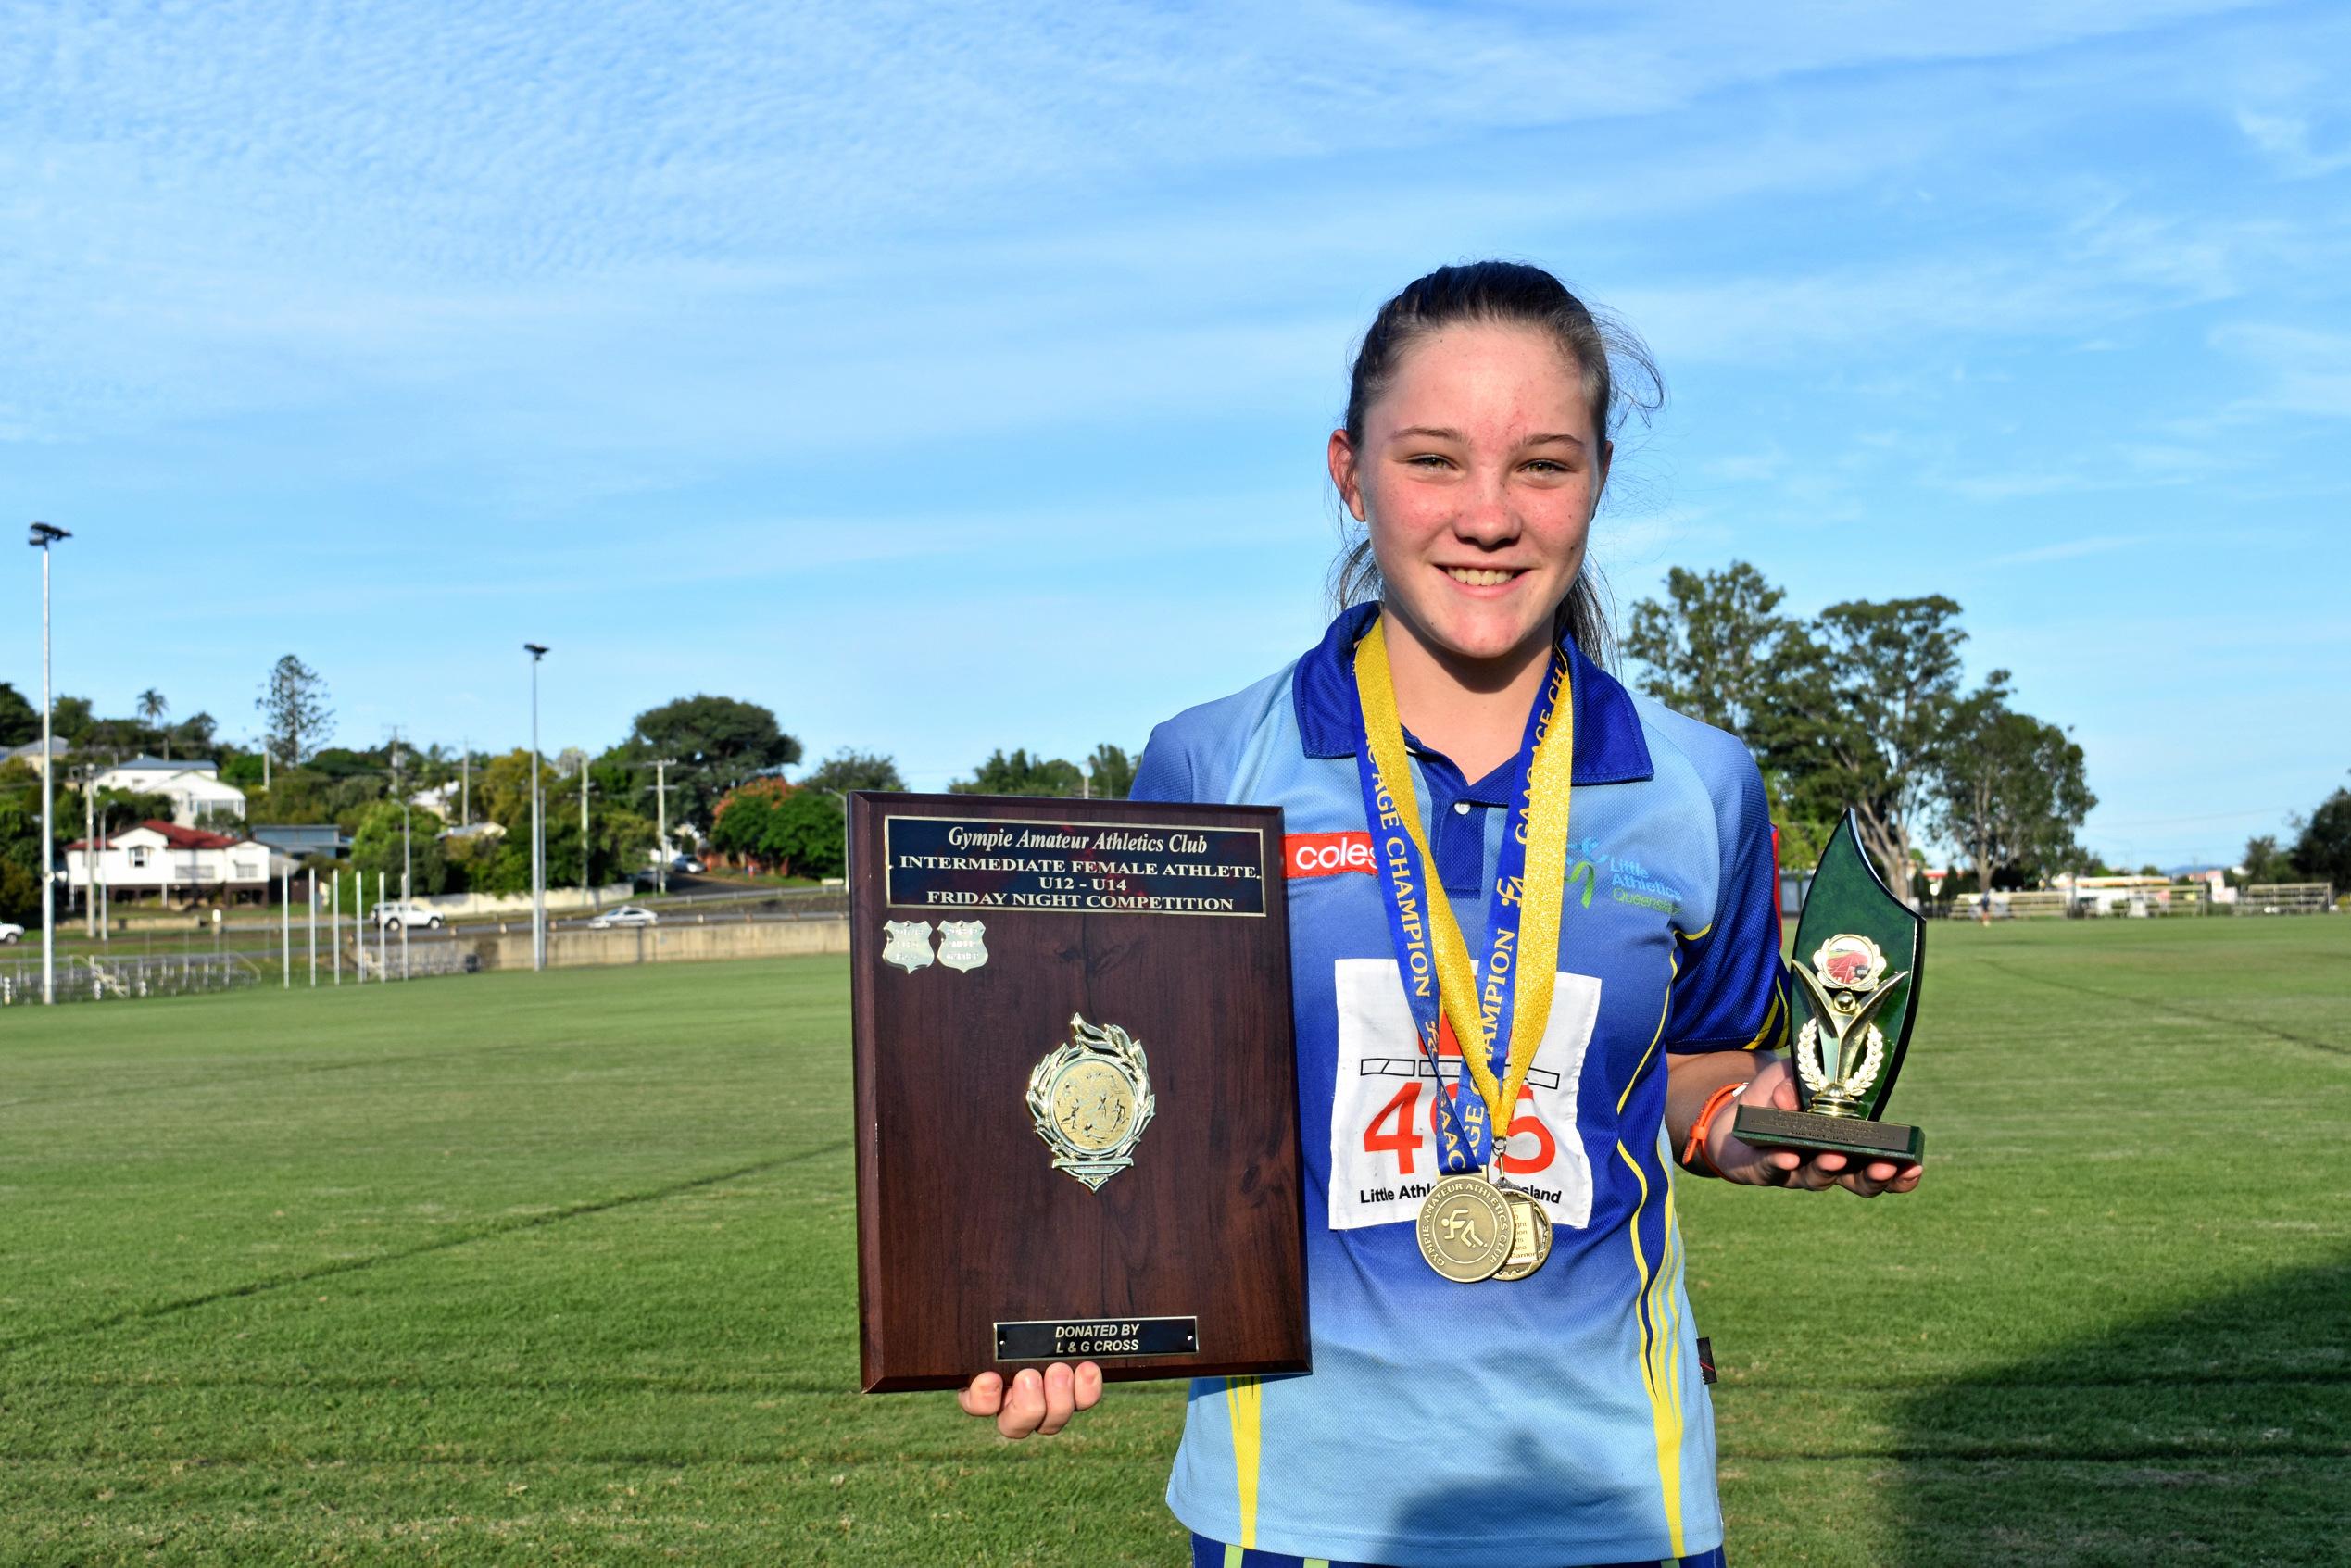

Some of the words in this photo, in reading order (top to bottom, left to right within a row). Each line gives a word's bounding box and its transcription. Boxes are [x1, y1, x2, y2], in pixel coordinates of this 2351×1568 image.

[948, 826, 1014, 851] Gympie
[1016, 829, 1089, 850] Amateur
[1093, 831, 1164, 853] Athletics
[1168, 834, 1208, 854] Club
[899, 855, 1065, 873] INTERMEDIATE
[1072, 861, 1158, 876] FEMALE
[1163, 863, 1255, 878] ATHLETE
[1610, 857, 1650, 878] Little
[1039, 877, 1074, 890] U12
[1092, 879, 1127, 891] U14
[1612, 873, 1682, 901] Athletics
[927, 891, 1007, 905] FRIDAY
[1012, 893, 1081, 908] NIGHT
[1086, 895, 1234, 910] COMPETITION
[1613, 887, 1682, 916] Queens
[1386, 836, 1431, 997] CHAMPION
[1363, 1082, 1556, 1175] 45
[1464, 1104, 1485, 1157] GE
[1360, 1185, 1395, 1204] Little
[1520, 1185, 1562, 1204] sland
[1424, 1183, 1463, 1222] AMATEUR
[1466, 1183, 1508, 1231] ATHLETICS
[1423, 1225, 1445, 1266] GYMPIE
[1489, 1234, 1507, 1263] CLUB
[1055, 1325, 1117, 1338] DONATED
[1121, 1323, 1139, 1336] BY
[1056, 1342, 1063, 1353] L
[1068, 1342, 1076, 1352] &
[1081, 1341, 1090, 1352] G
[1094, 1339, 1139, 1351] CROSS
